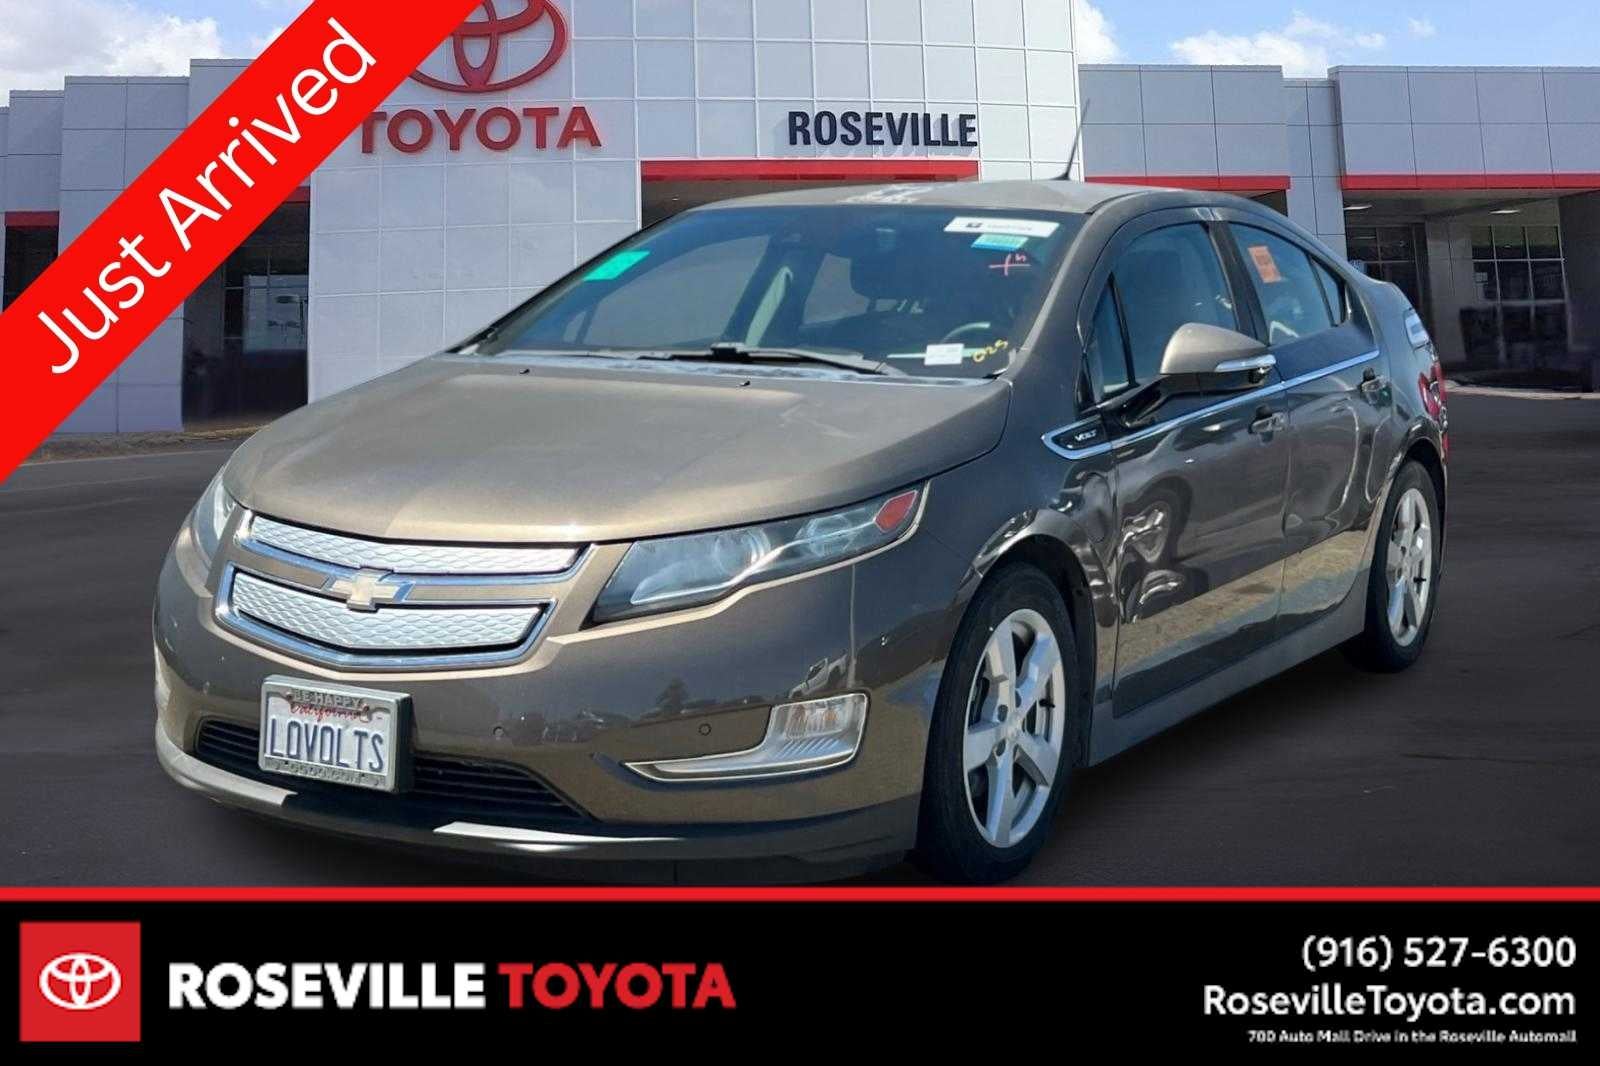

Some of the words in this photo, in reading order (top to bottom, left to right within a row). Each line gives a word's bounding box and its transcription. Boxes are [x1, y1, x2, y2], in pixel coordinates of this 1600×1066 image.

[361, 106, 602, 154] TOYOTA
[788, 110, 978, 147] ROSEVILLE
[1075, 429, 1097, 442] VOLT
[314, 692, 360, 708] HAPPY
[269, 718, 384, 772] LOVOLTS
